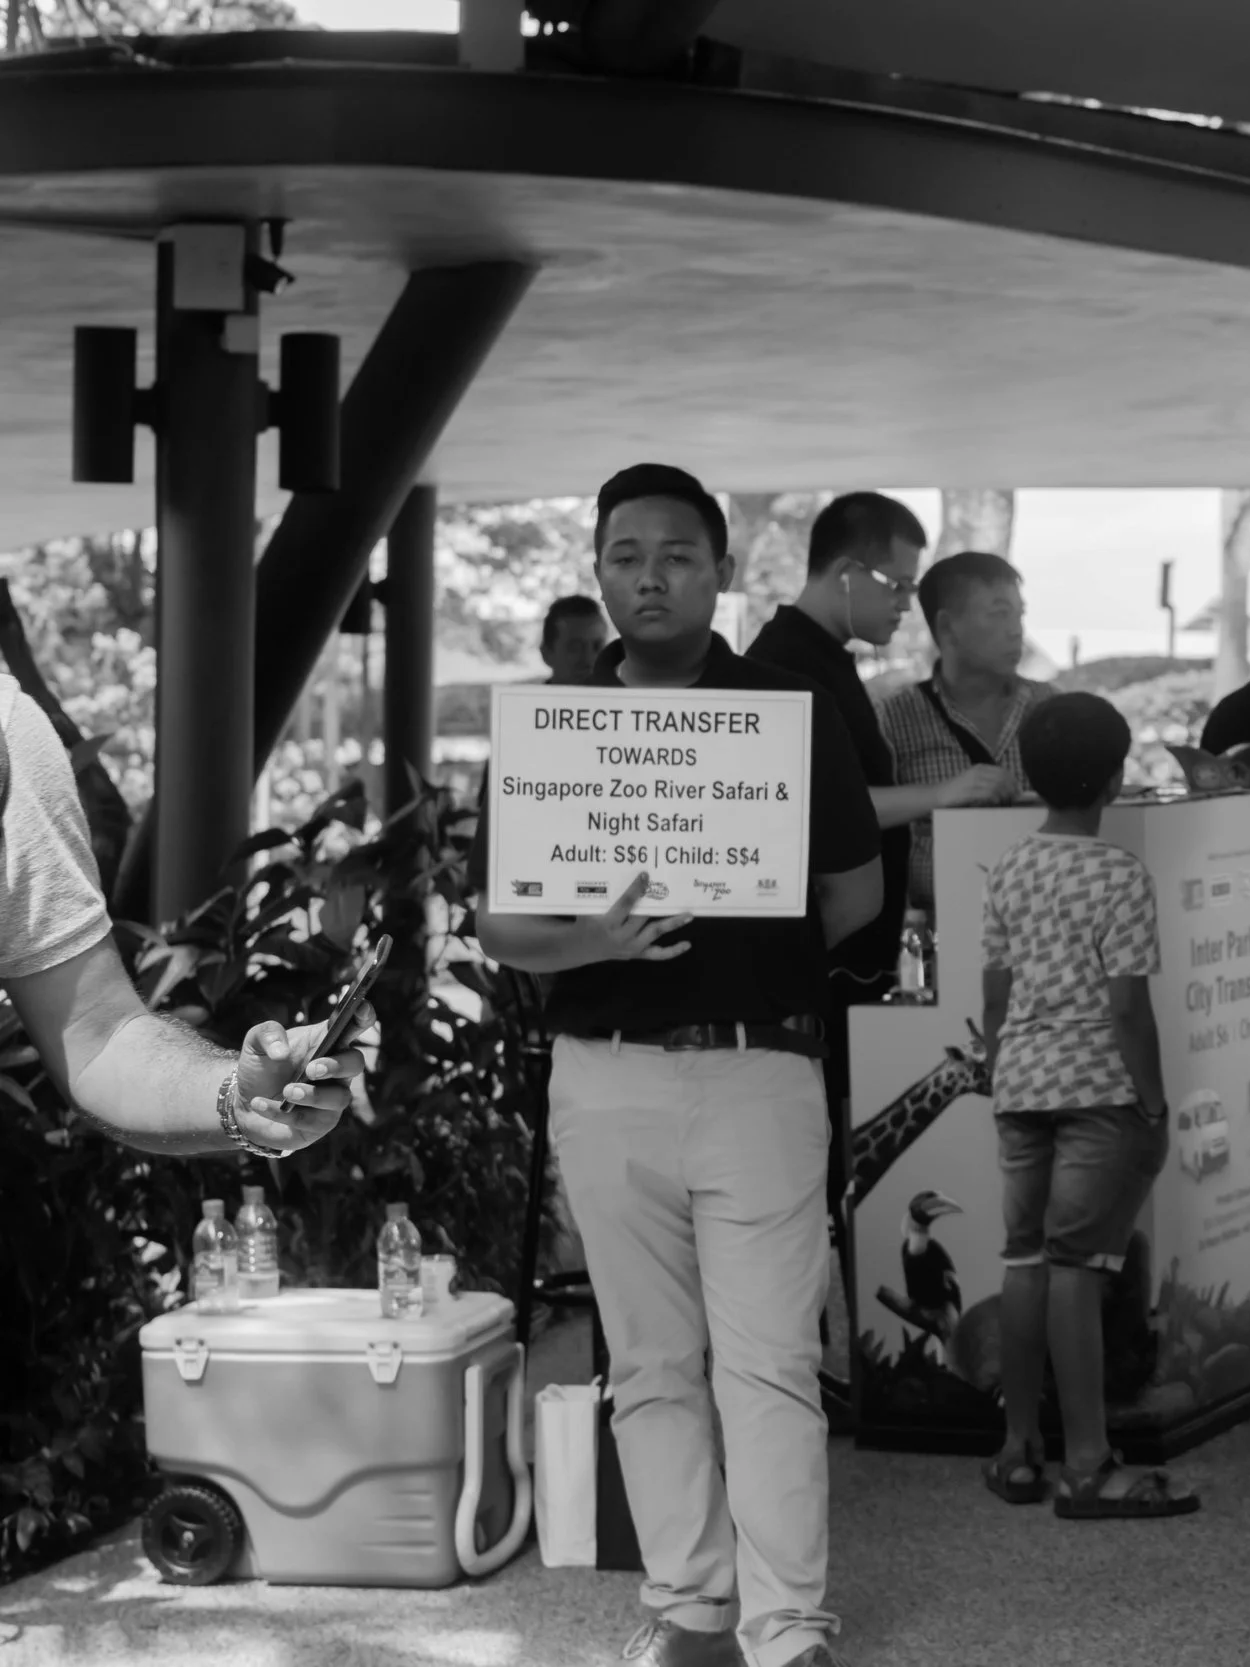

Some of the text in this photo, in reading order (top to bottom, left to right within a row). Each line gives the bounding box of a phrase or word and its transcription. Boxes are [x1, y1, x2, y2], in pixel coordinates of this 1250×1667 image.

[534, 707, 761, 735] DIRECT TRANSFER
[596, 746, 698, 767] TOWARDS
[502, 776, 790, 802] Singapore Zoo River Safari &
[587, 811, 704, 836] Night Safari
[550, 844, 607, 864] Adult:
[613, 844, 649, 865] S$6
[665, 845, 720, 866] Child:
[726, 846, 761, 867] S$4
[1190, 937, 1223, 968] Inter
[1185, 980, 1213, 1018] City
